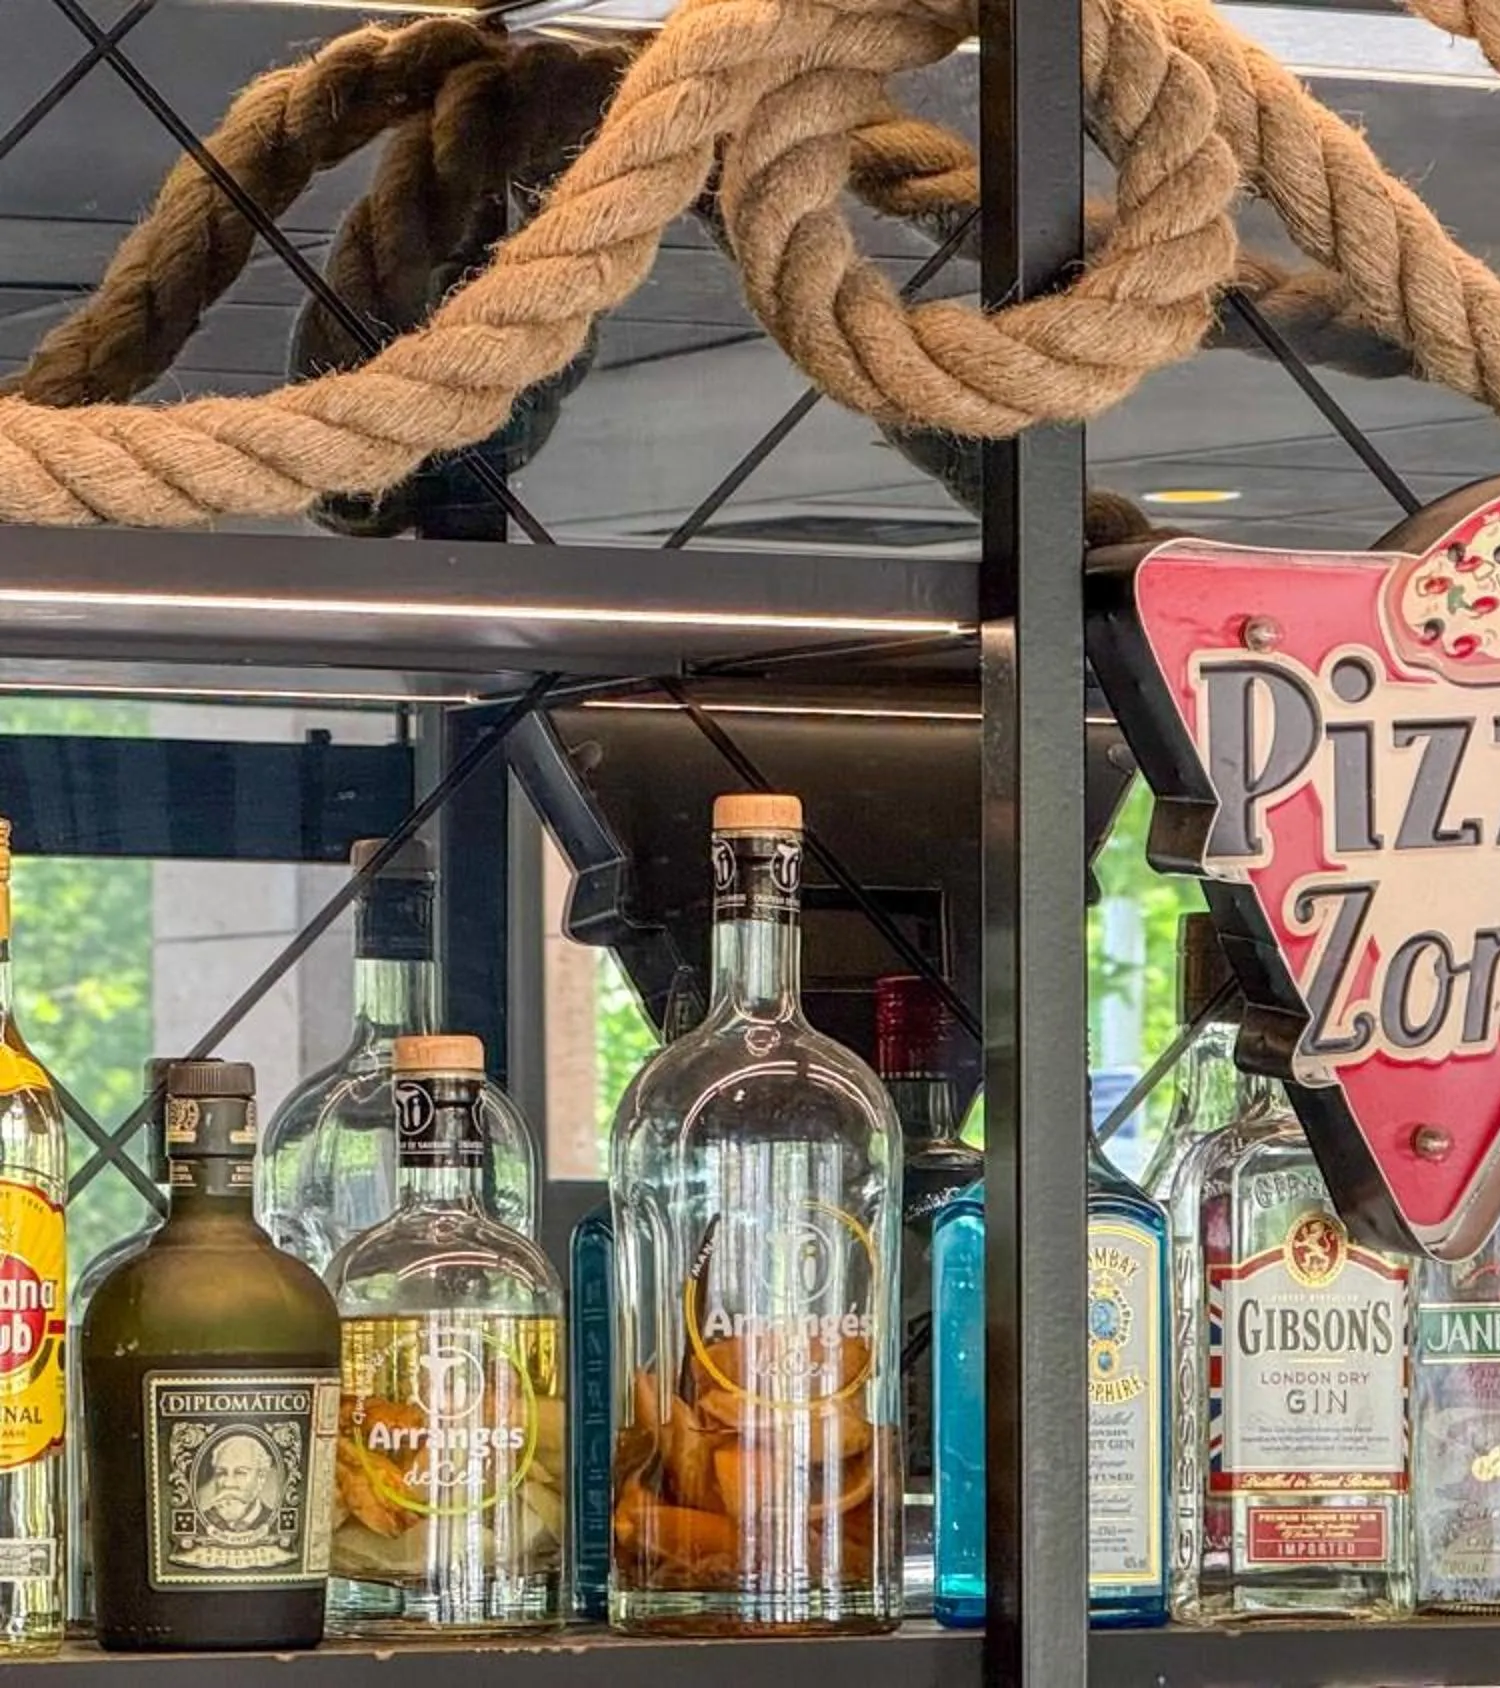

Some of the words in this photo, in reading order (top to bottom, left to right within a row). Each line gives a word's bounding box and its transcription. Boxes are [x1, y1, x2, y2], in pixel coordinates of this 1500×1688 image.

[1088, 1248, 1140, 1277] MBAY
[0, 1279, 54, 1310] ana
[0, 1312, 33, 1355] ub
[1237, 1299, 1393, 1355] GIBSON'S
[1088, 1373, 1142, 1401] PHIRE
[1261, 1372, 1331, 1385] LONDON
[1338, 1371, 1371, 1385] DRY
[1286, 1388, 1347, 1415] GIN
[1278, 1543, 1356, 1555] IMPORTED
